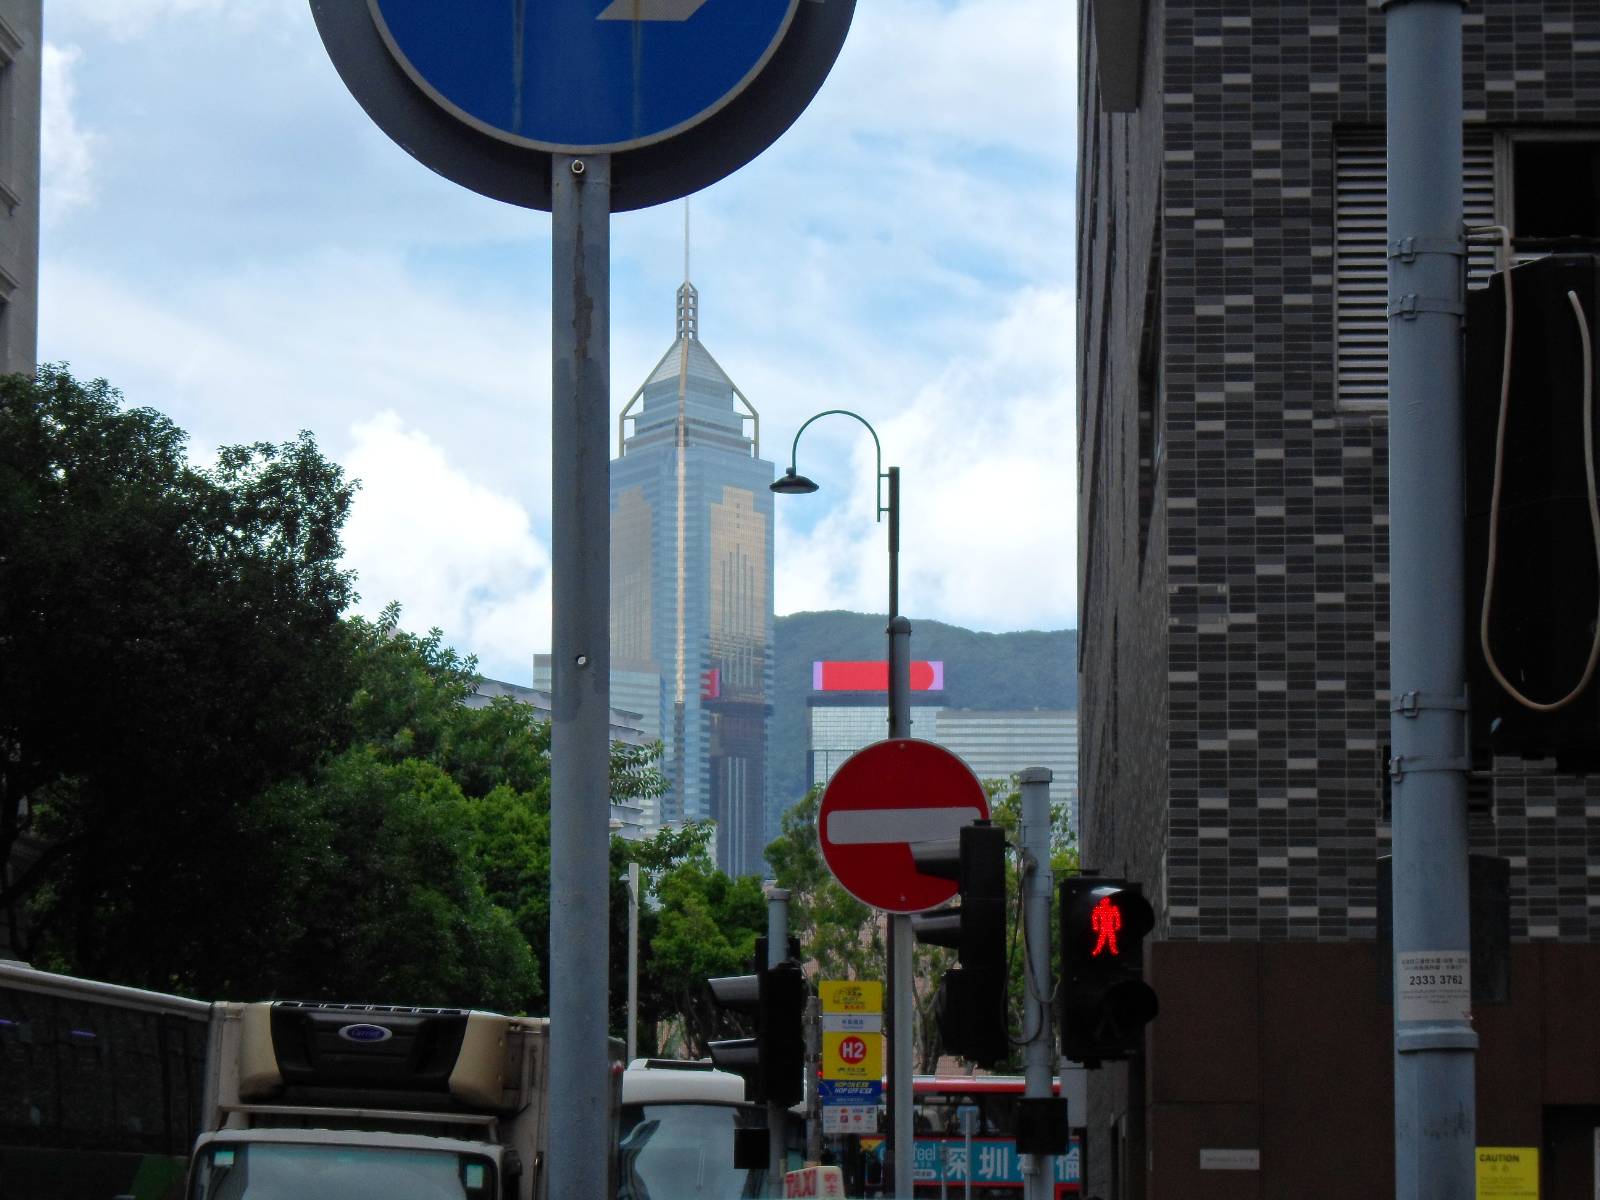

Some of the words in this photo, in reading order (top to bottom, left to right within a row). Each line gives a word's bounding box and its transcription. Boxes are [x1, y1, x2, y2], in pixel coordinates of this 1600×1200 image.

[1409, 975, 1436, 986] 2333
[1439, 974, 1463, 985] 3762
[842, 1041, 865, 1059] H2
[1479, 1153, 1520, 1162] CAUTION
[785, 1168, 817, 1199] TAXI
